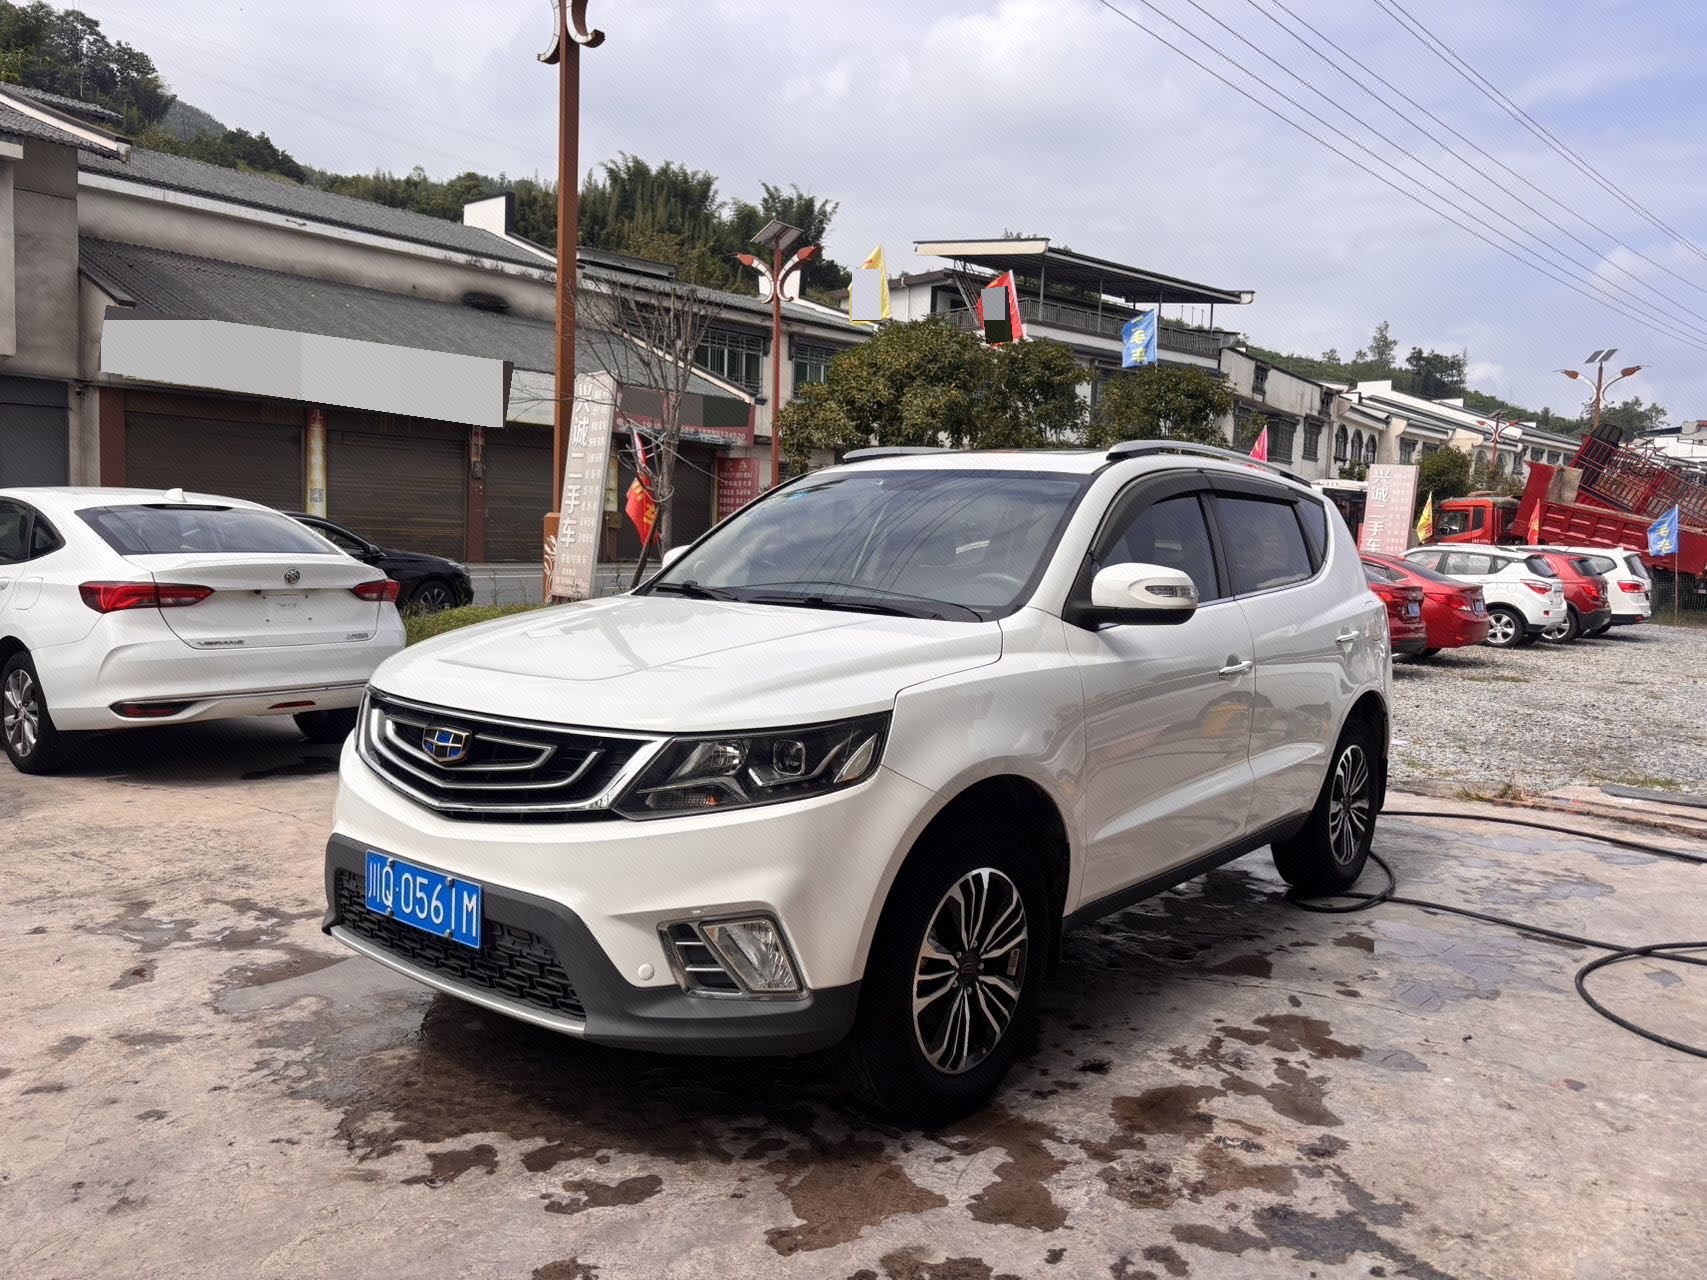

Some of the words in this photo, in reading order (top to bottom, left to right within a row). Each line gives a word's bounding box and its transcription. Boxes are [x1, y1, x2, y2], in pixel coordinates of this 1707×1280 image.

[560, 383, 593, 548] 兴诚二手车
[1364, 468, 1392, 553] 兴诚二手车
